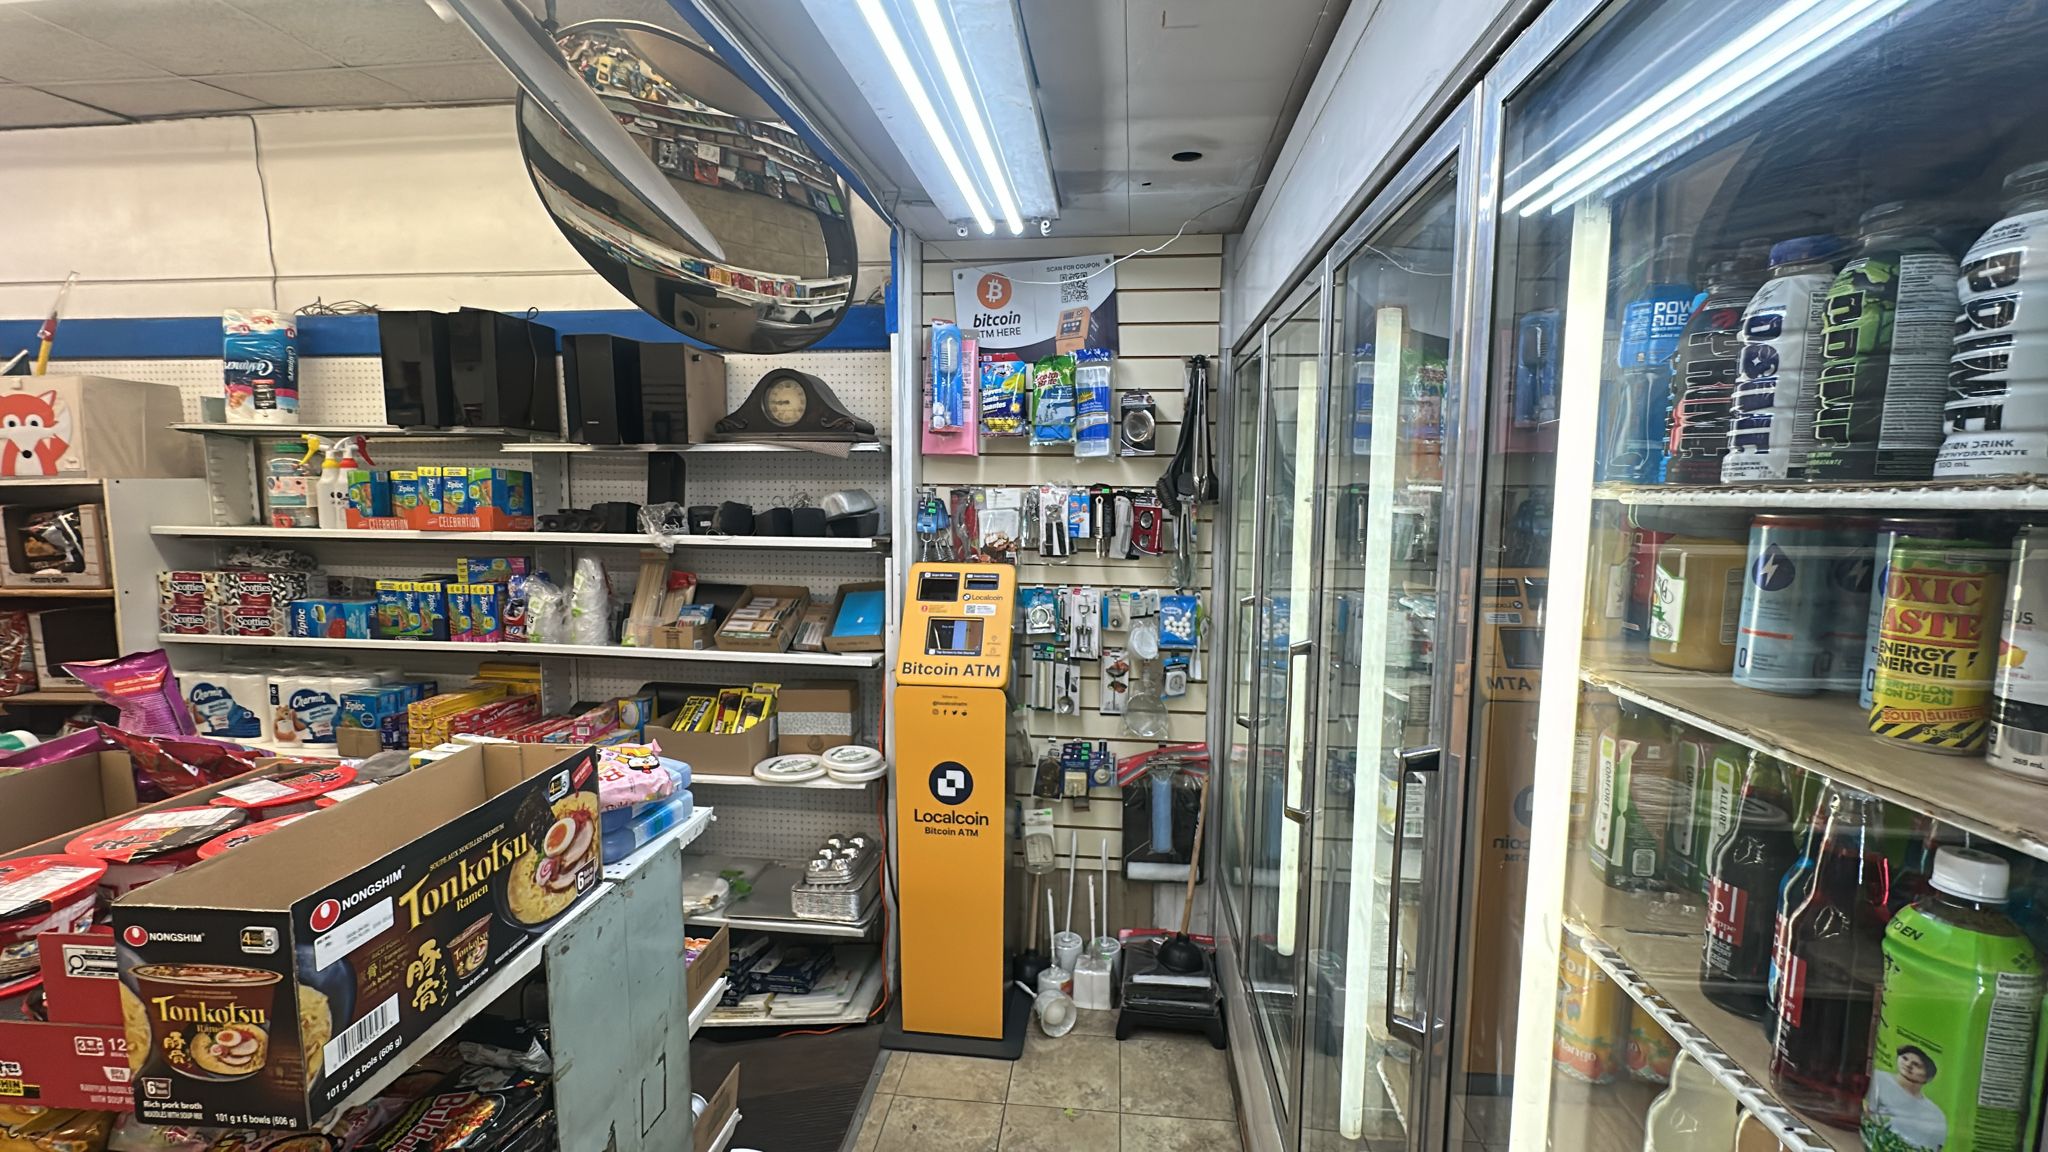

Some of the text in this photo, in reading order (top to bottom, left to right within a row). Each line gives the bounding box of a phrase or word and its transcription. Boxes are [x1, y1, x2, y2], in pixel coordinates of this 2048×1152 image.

[1076, 262, 1100, 270] COUPON
[1654, 300, 1690, 315] POW
[973, 310, 1021, 328] bitcoin
[1651, 313, 1689, 327] ADE
[979, 327, 1021, 339] TM HERE
[1972, 439, 2014, 449] DRINK
[399, 485, 416, 494] Ziploc
[447, 481, 464, 490] Ziploc
[368, 518, 409, 530] CELEBRATION
[438, 515, 480, 529] CELEBRATION
[469, 564, 490, 573] Ziploc
[172, 582, 206, 593] Scotties
[240, 582, 272, 593] Scotties
[1888, 574, 1983, 607] OXIC
[172, 614, 205, 625] Scotties
[238, 616, 271, 627] Scotties
[298, 608, 307, 636] Ziploc
[1882, 606, 1983, 640] ASTE
[1878, 640, 1957, 663] ENERGY
[902, 661, 1000, 678] Bitcoin ATM
[193, 688, 223, 702] Charmin
[292, 694, 326, 709] Charmin
[344, 700, 366, 712] Ziploc
[1883, 708, 1923, 721] SOUR
[1603, 760, 1612, 807] COMFORT
[1719, 786, 1729, 830] ALLURE
[913, 808, 989, 826] Localcoin
[481, 822, 505, 841] PREMIUM
[924, 826, 979, 837] Bitcoin ATM
[398, 831, 528, 933] Tonkotsu
[577, 872, 584, 891] 6
[341, 869, 402, 911] NONGSHIM
[456, 884, 488, 912] Ramen
[149, 932, 202, 943] NONGSHIM
[241, 932, 250, 946] 4
[1900, 926, 1924, 941] EN
[453, 931, 489, 961] Tonkotsu
[151, 995, 266, 1024] Tonkotsu
[196, 1024, 225, 1034] Rame
[107, 1038, 128, 1051] 12
[326, 1034, 403, 1101] 101 g x 6 bols (606 g)
[0, 1079, 20, 1088] HIN
[146, 1080, 157, 1095] 6
[124, 1096, 135, 1104] MI
[143, 1100, 203, 1111] Rich pork broth
[143, 1110, 167, 1119] NOODLES
[166, 1111, 181, 1119] WITH
[180, 1111, 193, 1119] SOUP
[215, 1113, 228, 1122] 101
[229, 1115, 236, 1124] g
[242, 1114, 248, 1123] 6
[249, 1114, 271, 1124] bowls
[272, 1116, 288, 1127] (606
[289, 1117, 297, 1128] g)
